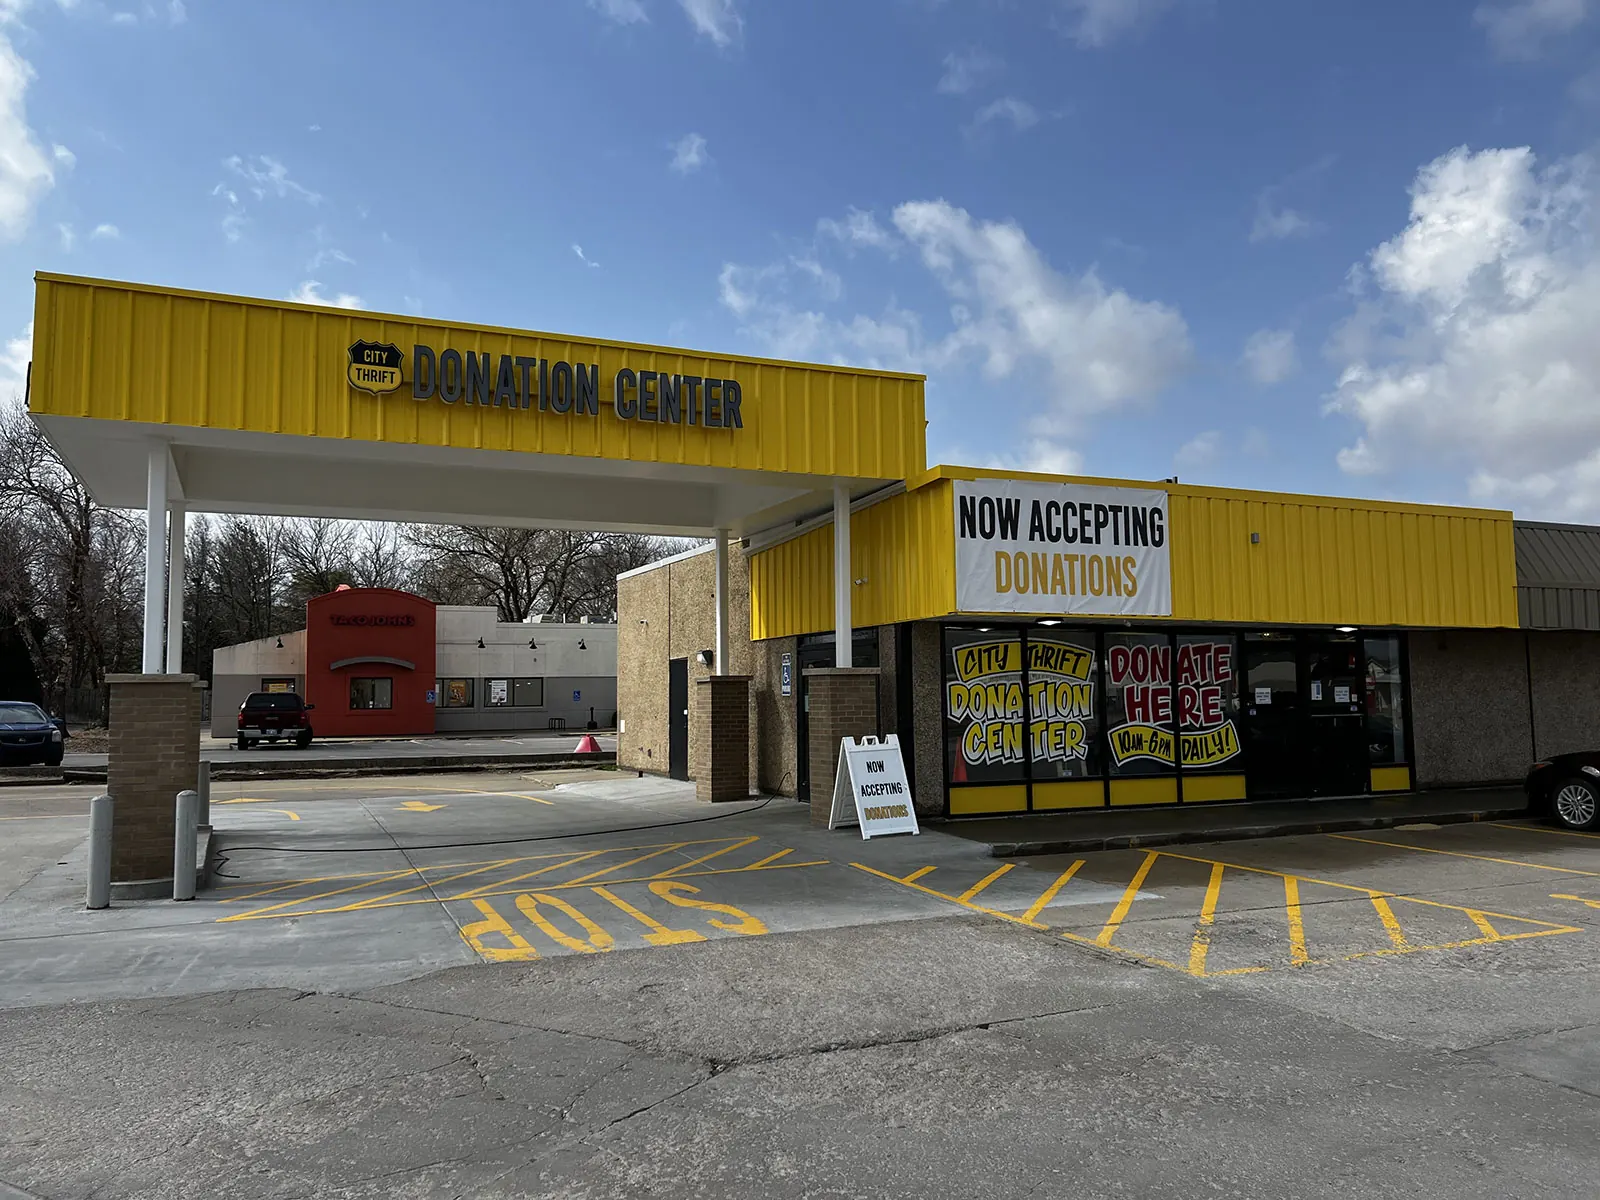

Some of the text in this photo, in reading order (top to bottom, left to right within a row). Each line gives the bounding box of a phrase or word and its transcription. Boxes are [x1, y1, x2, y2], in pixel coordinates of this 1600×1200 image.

[355, 366, 396, 385] THRIFT
[363, 349, 388, 365] CITY
[413, 343, 744, 429] DONATION CENTER
[959, 495, 1164, 548] NOW ACCEPTING
[995, 551, 1138, 598] DONATIONS
[330, 614, 368, 626] TACO
[964, 643, 1087, 676] CITY THRIFT
[1109, 643, 1232, 686] DONATE
[948, 680, 1094, 722] DONATION
[1124, 685, 1224, 727] HERE
[962, 719, 1088, 765] CENTER
[1181, 729, 1232, 761] DAILY!
[866, 760, 885, 773] NOW
[861, 782, 902, 797] ACCEPTING
[864, 804, 909, 820] DONATIONS
[459, 880, 769, 962] STOP
